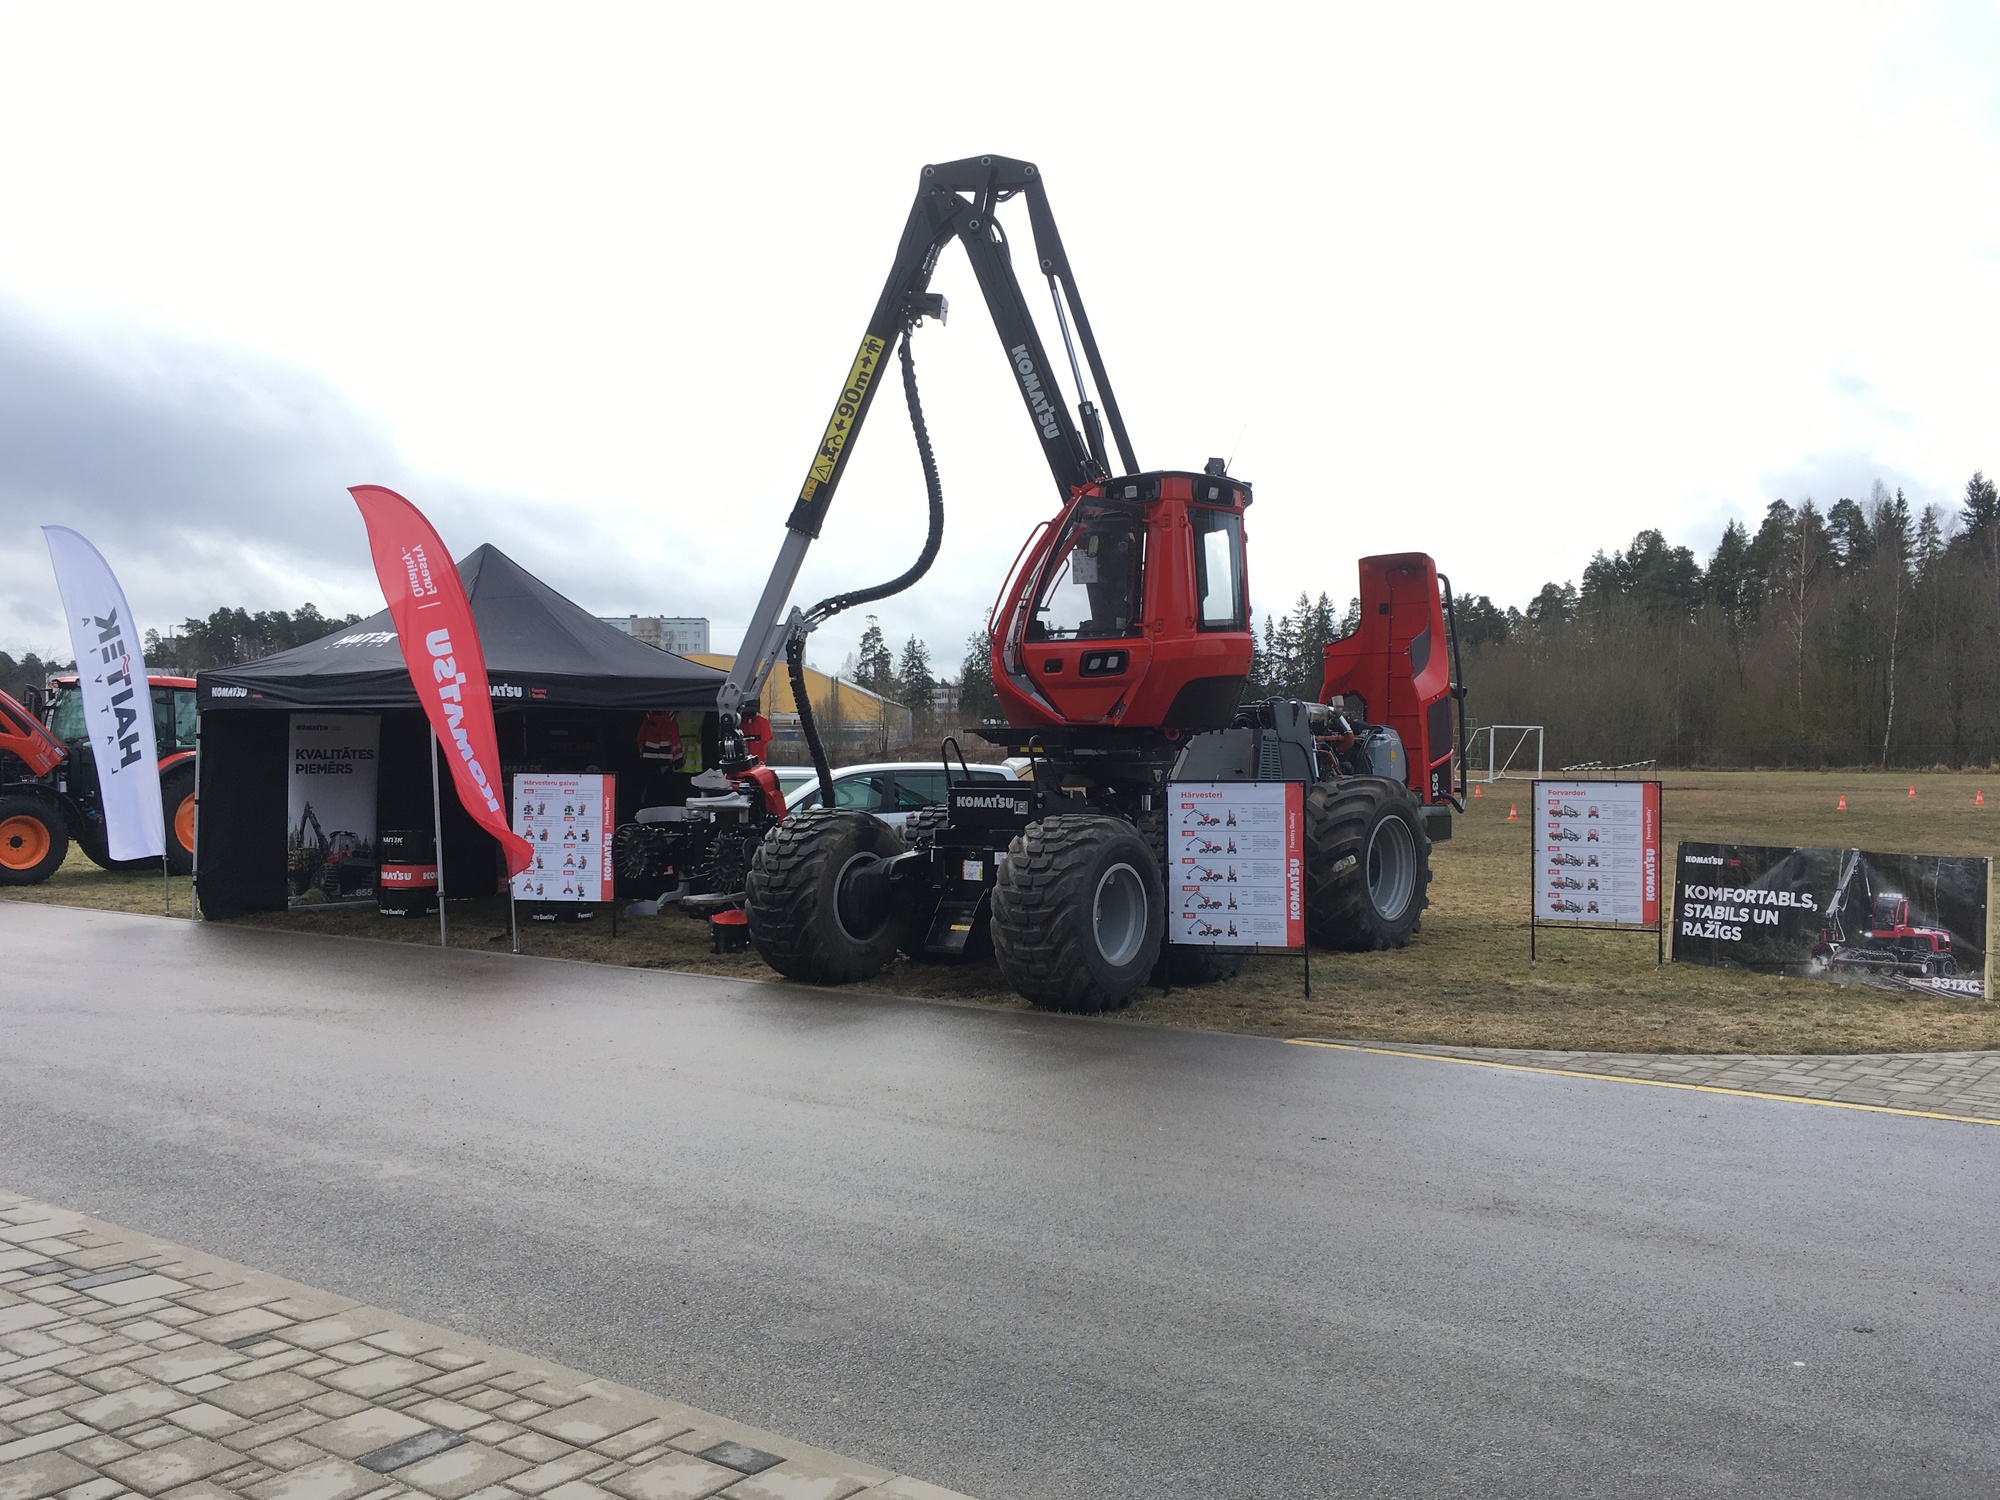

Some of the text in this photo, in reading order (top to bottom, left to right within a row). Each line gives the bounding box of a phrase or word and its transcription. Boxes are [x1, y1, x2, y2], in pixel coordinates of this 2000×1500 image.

[838, 371, 870, 418] 90m
[1011, 344, 1060, 439] KOMATSU
[211, 686, 248, 698] KOMATSU
[489, 683, 522, 698] ATSU
[295, 746, 375, 760] KVALITĀTES
[295, 761, 353, 775] PIEMĒRS
[1431, 772, 1439, 796] 931
[956, 794, 1014, 809] KOMATSU
[603, 833, 613, 881] KOMATSU
[1685, 855, 1724, 866] KOMATSU
[1644, 848, 1656, 901] KOMATSU
[355, 888, 373, 897] 855
[1287, 859, 1300, 920] KOMATSU
[1684, 884, 1819, 912] KOMFORTABLS,
[1683, 903, 1779, 925] STABILS UN
[1682, 920, 1742, 942] RAŽĪGS
